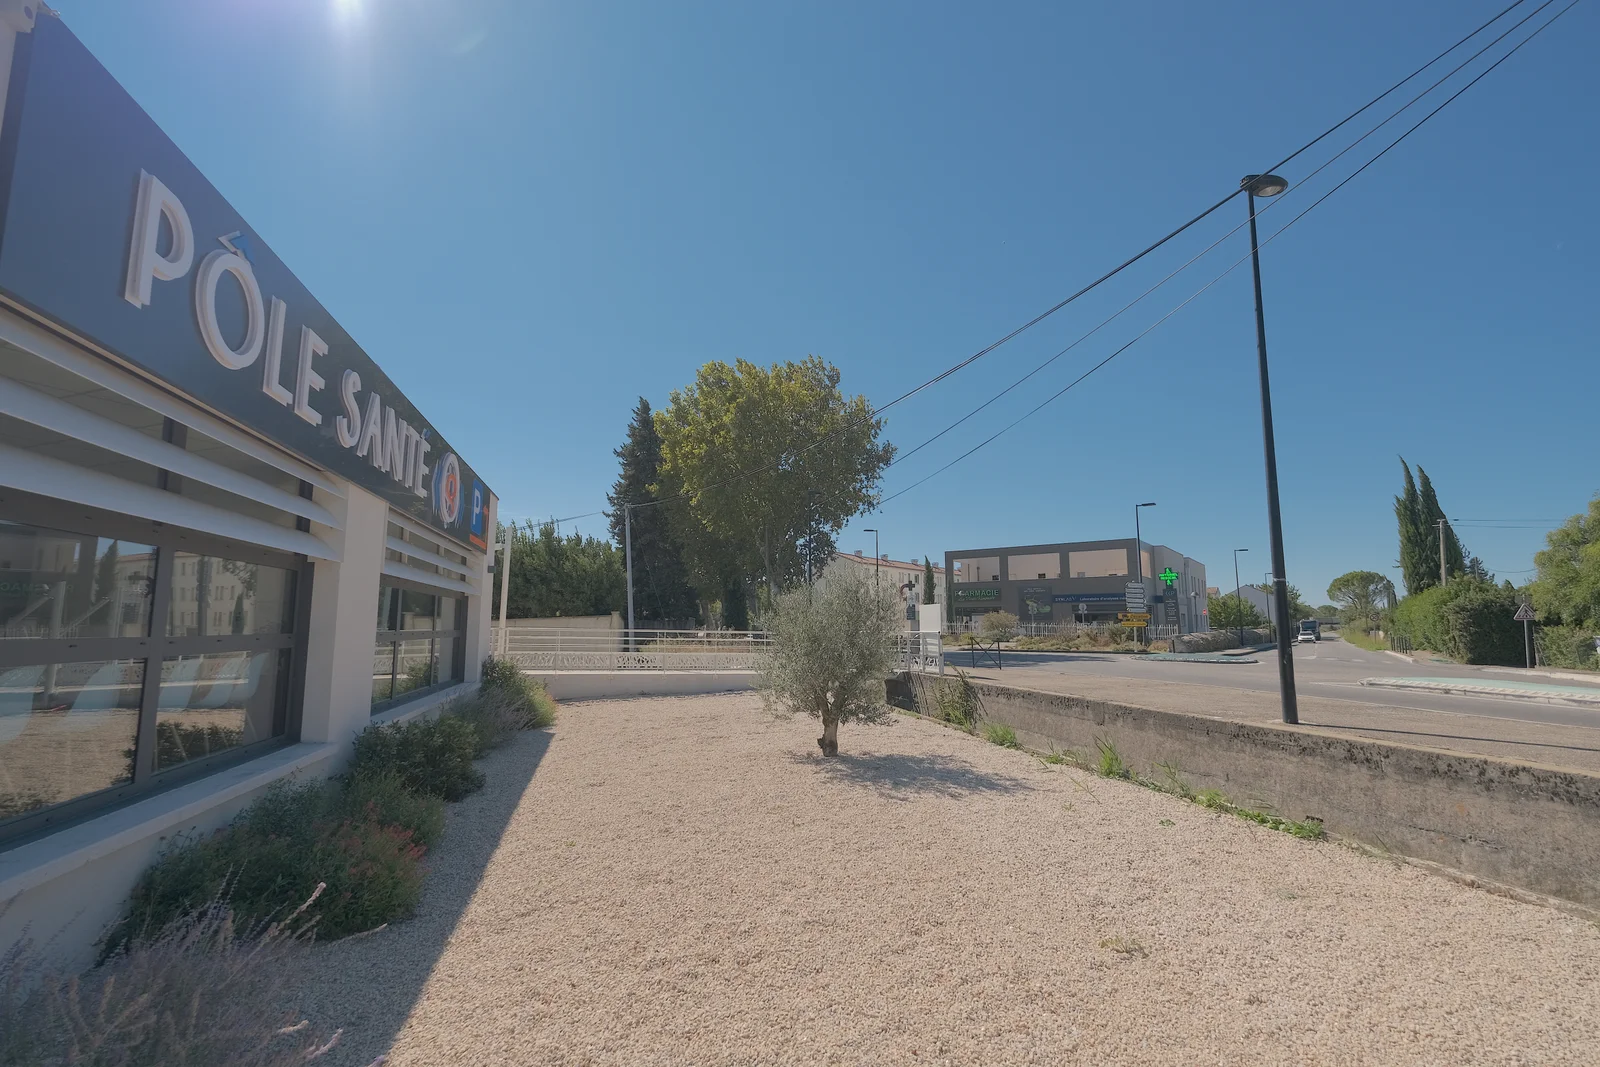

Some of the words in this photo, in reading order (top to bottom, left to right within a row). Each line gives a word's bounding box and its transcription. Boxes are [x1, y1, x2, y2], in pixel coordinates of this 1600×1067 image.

[124, 168, 329, 428] PÔLE
[336, 368, 432, 499] SANTÉ
[472, 487, 481, 526] P
